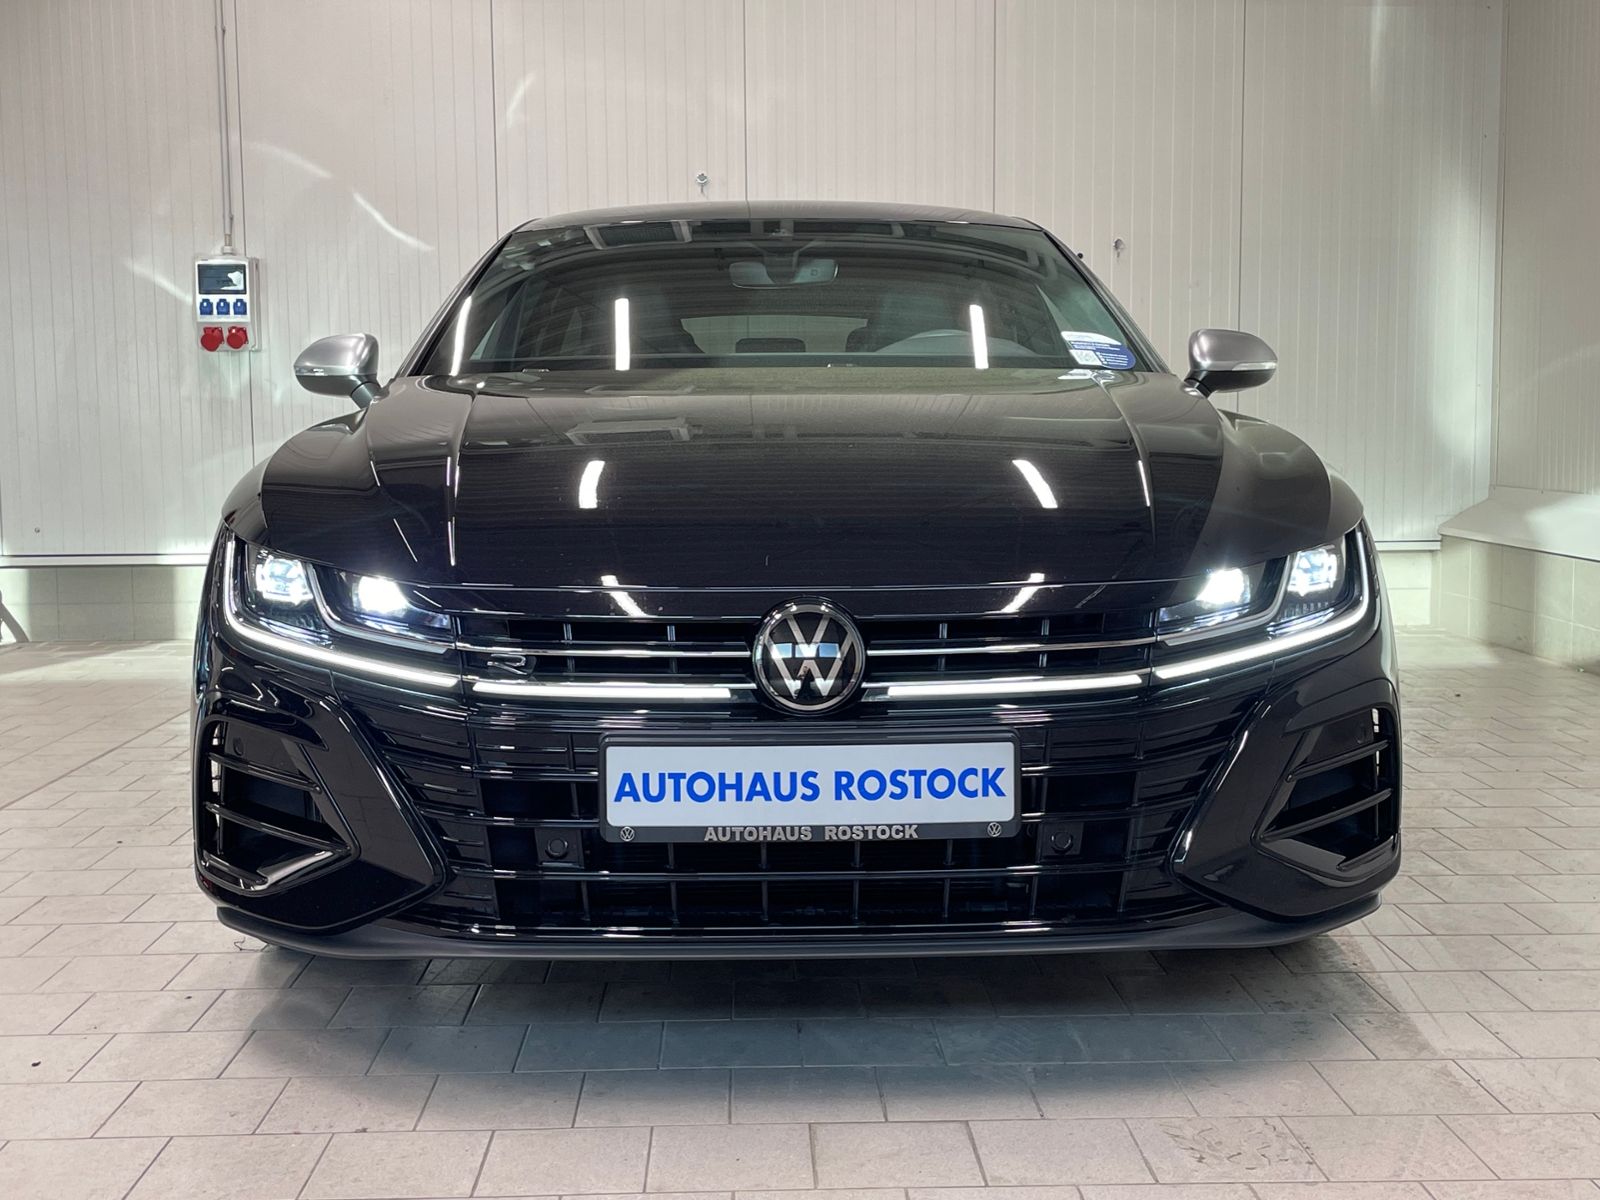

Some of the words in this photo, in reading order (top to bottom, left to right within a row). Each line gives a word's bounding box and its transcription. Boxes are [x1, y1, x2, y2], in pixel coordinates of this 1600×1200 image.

[613, 770, 820, 803] AUTOHAUS
[834, 767, 1006, 801] ROSTOCK
[704, 826, 812, 841] AUTOHAUS
[825, 824, 919, 840] ROSTOCK
